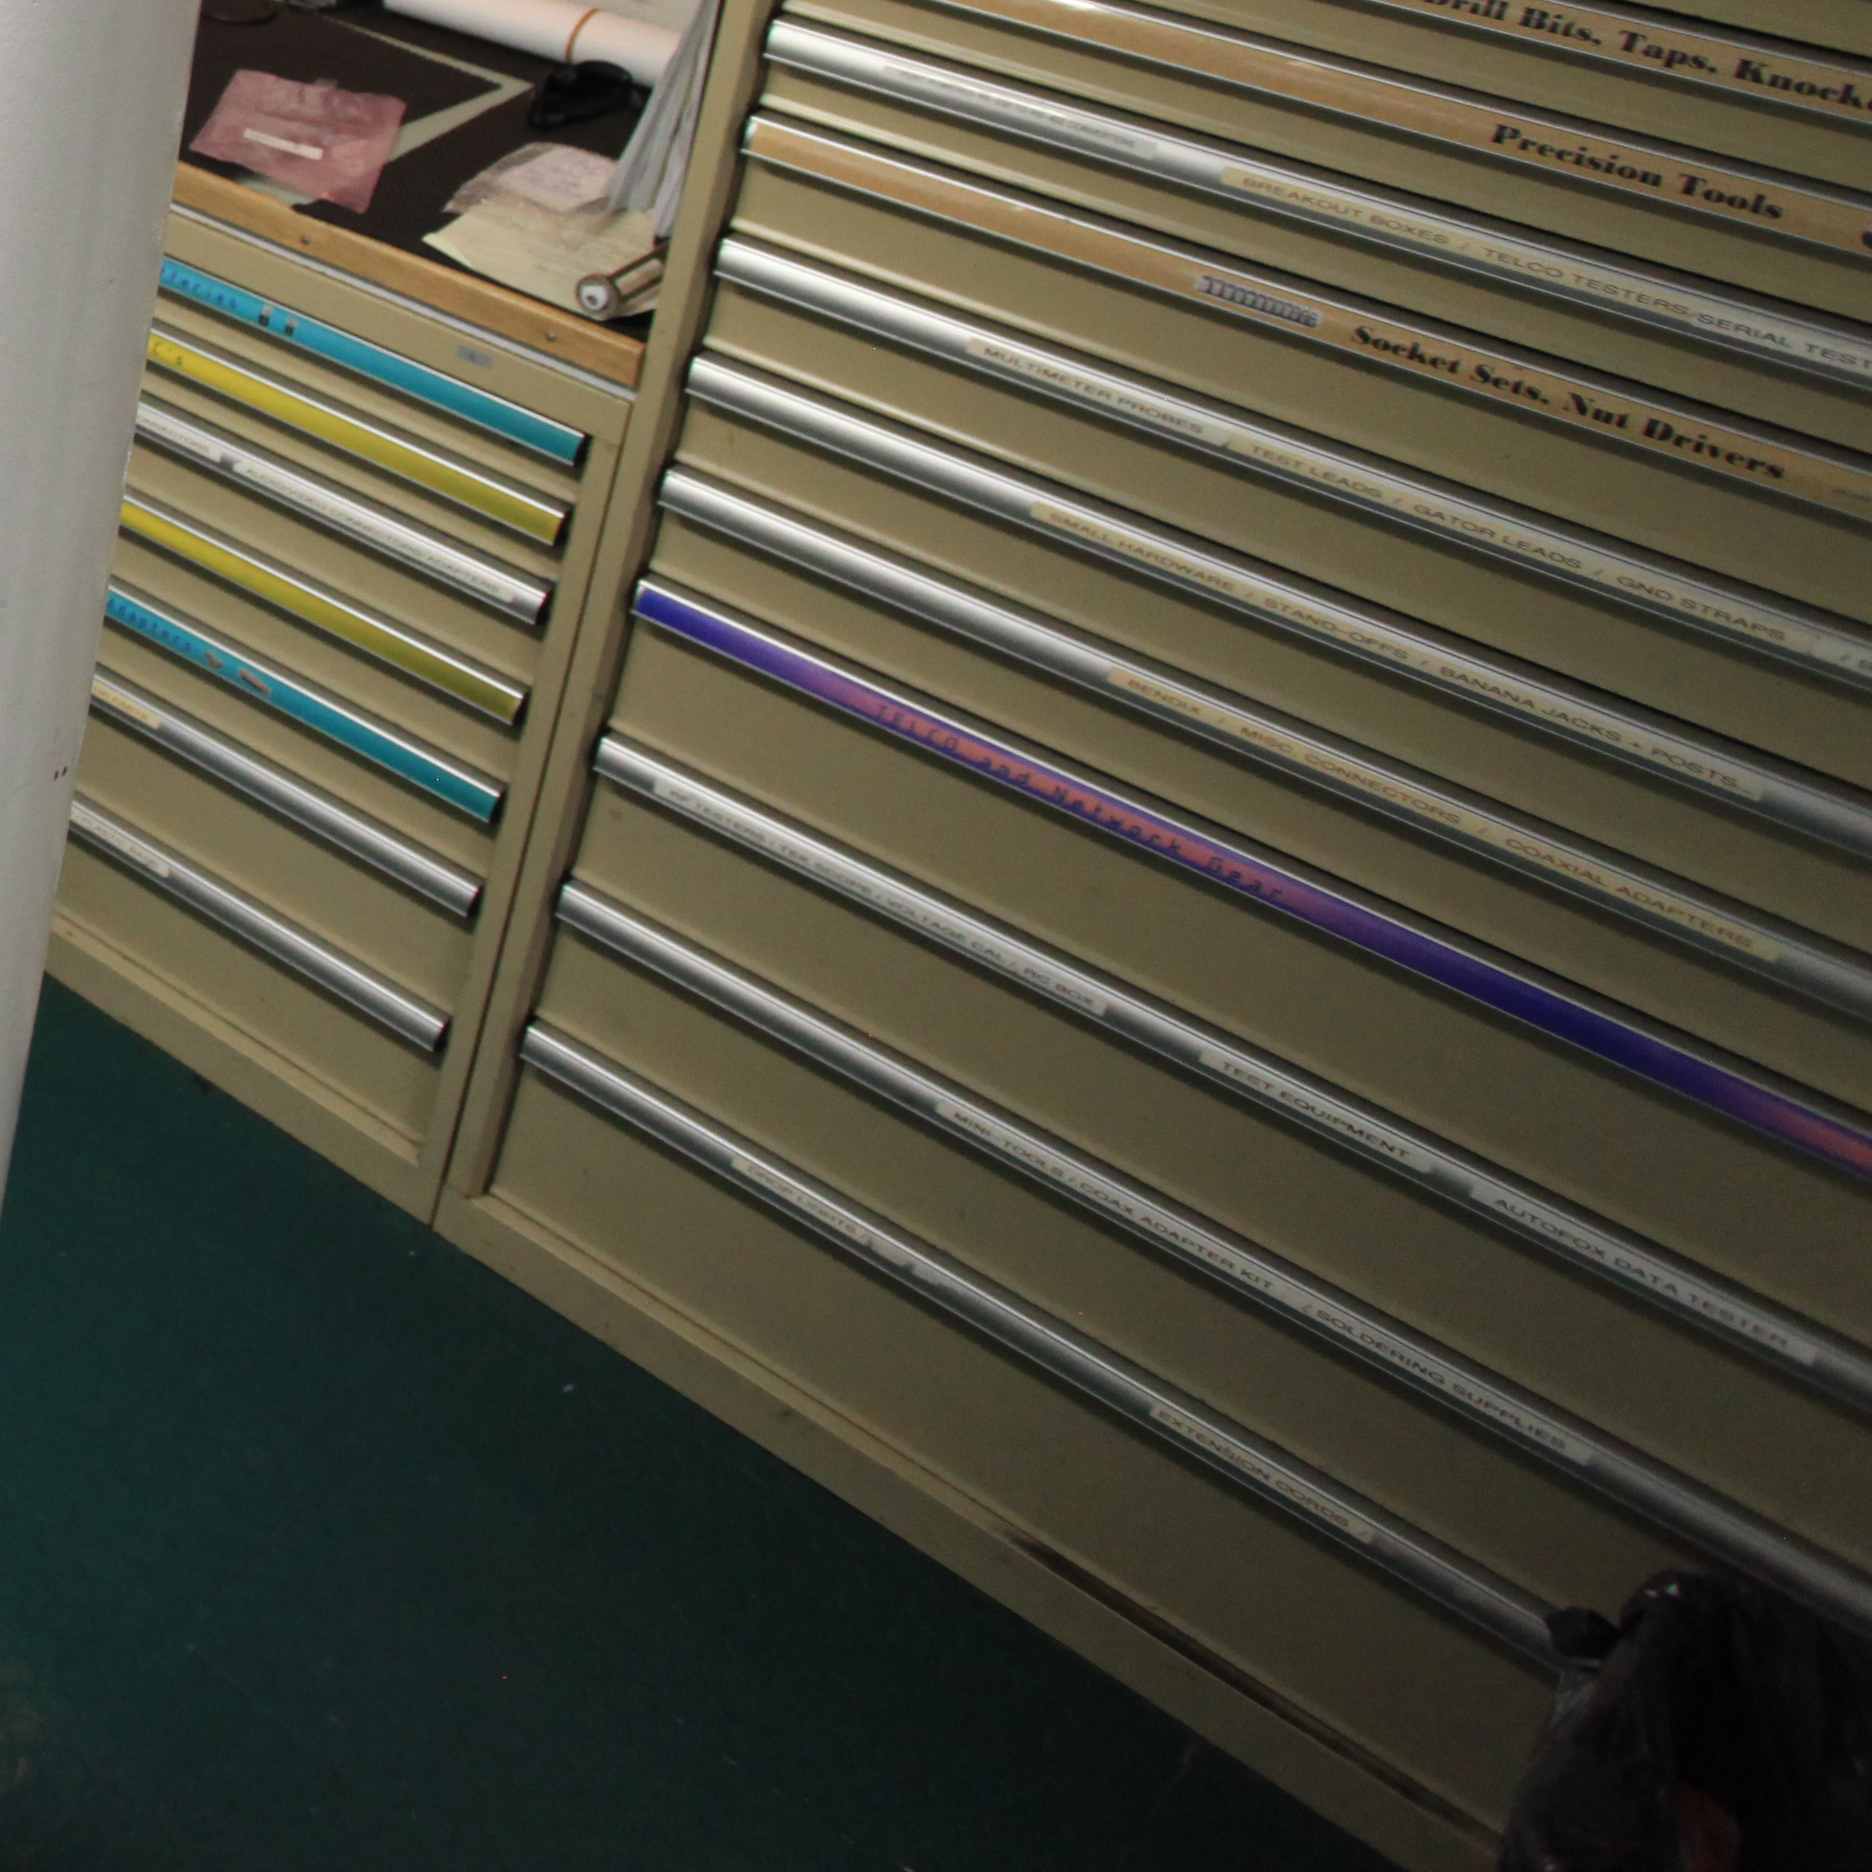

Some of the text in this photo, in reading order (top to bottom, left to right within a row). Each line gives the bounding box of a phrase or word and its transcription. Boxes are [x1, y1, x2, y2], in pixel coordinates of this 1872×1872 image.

[1242, 176, 1363, 219] BREAKOUT
[1370, 213, 1450, 246] BOXES
[1483, 246, 1564, 278] TELCO
[1490, 124, 1784, 220] Precision Tools
[982, 342, 1205, 438] MULTIMETER PROBES
[1350, 324, 1461, 375] Socket
[1563, 391, 1629, 431] Nut
[1643, 418, 1786, 480] Drivers
[1251, 445, 1305, 473] TEST
[1309, 467, 1383, 499] LEADS
[1413, 504, 1496, 540] GATOR
[1502, 535, 1582, 570] LEADS
[1617, 575, 1673, 602] GND
[1680, 597, 1787, 642] STRAPS
[1049, 512, 1113, 543] SMALL
[1118, 539, 1234, 591] HARDWARE
[1263, 598, 1408, 660] STAND-OFFS
[1440, 666, 1535, 711] BANANA
[1541, 709, 1621, 744] JACKS
[977, 757, 1033, 786] and
[1054, 788, 1187, 856] Network
[1207, 855, 1282, 899] Gear
[1127, 679, 1200, 718] BENDIX
[1304, 755, 1461, 823] CONNECTORS
[1506, 838, 1608, 888] COAXIAL
[1616, 886, 1753, 949] ADAPTERS
[1219, 1060, 1411, 1160] TEST EQUIPMENT
[1079, 1182, 1135, 1217] COAX
[1138, 1212, 1233, 1265] ADAPTER
[1237, 1264, 1276, 1291] KIT
[1314, 1310, 1445, 1386] SOLDERING
[1449, 1384, 1569, 1453] SUPPLIES
[1613, 1257, 1683, 1298] DATA
[1684, 1293, 1791, 1349] TESTER
[1156, 1409, 1351, 1529] EXTENSION CORDS
